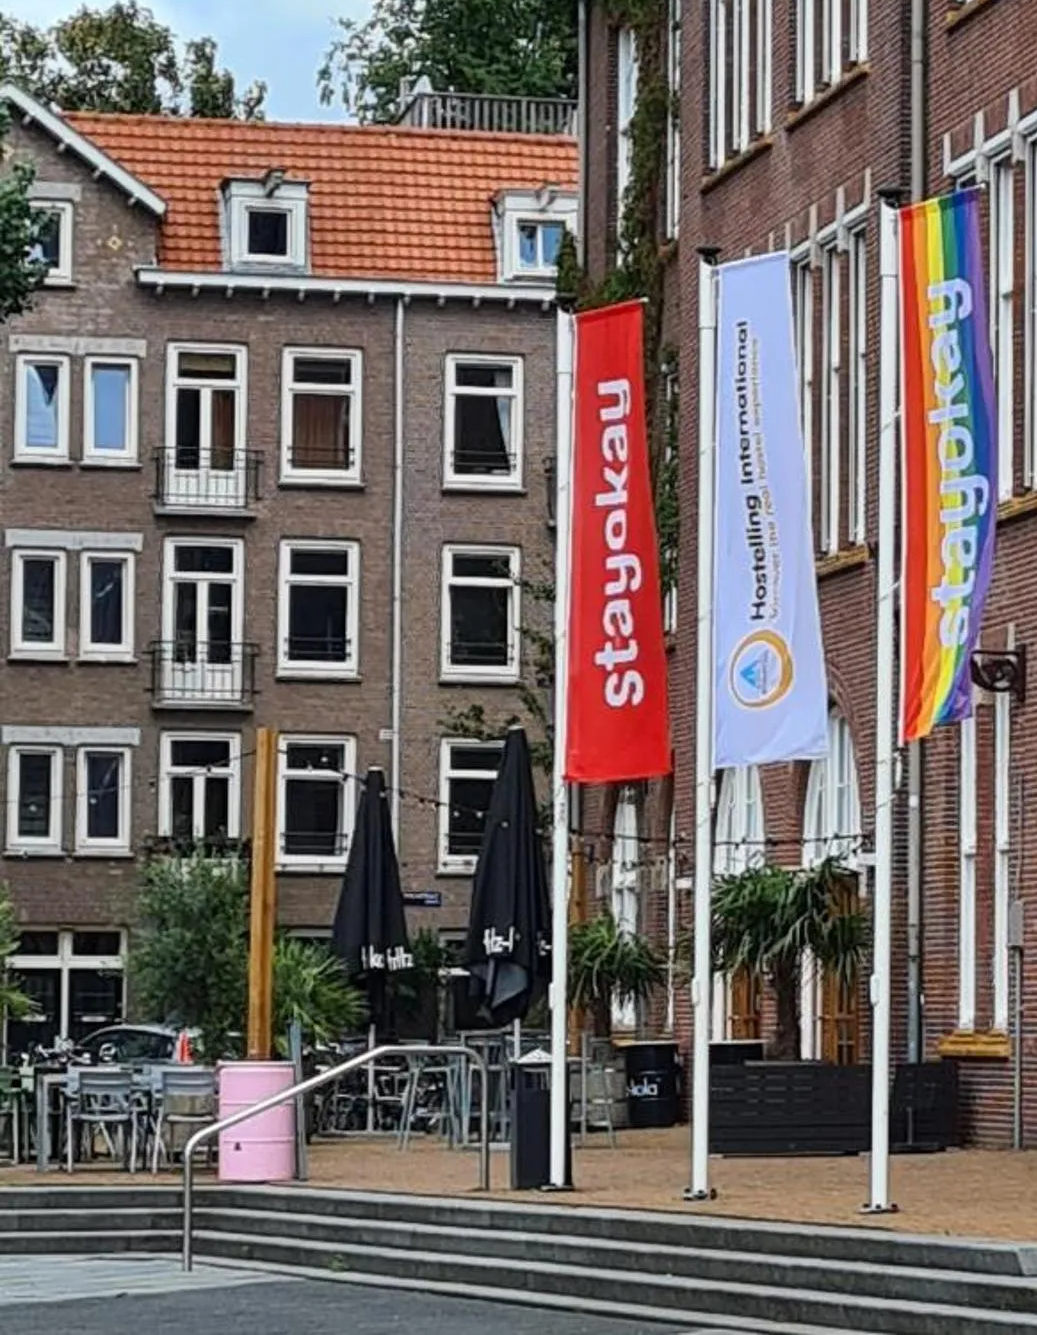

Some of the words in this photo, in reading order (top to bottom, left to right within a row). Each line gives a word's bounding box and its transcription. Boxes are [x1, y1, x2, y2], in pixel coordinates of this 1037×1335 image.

[735, 321, 754, 484] International
[927, 277, 988, 647] stayokay
[594, 378, 645, 708] stayokay
[745, 494, 767, 620] Hostelling
